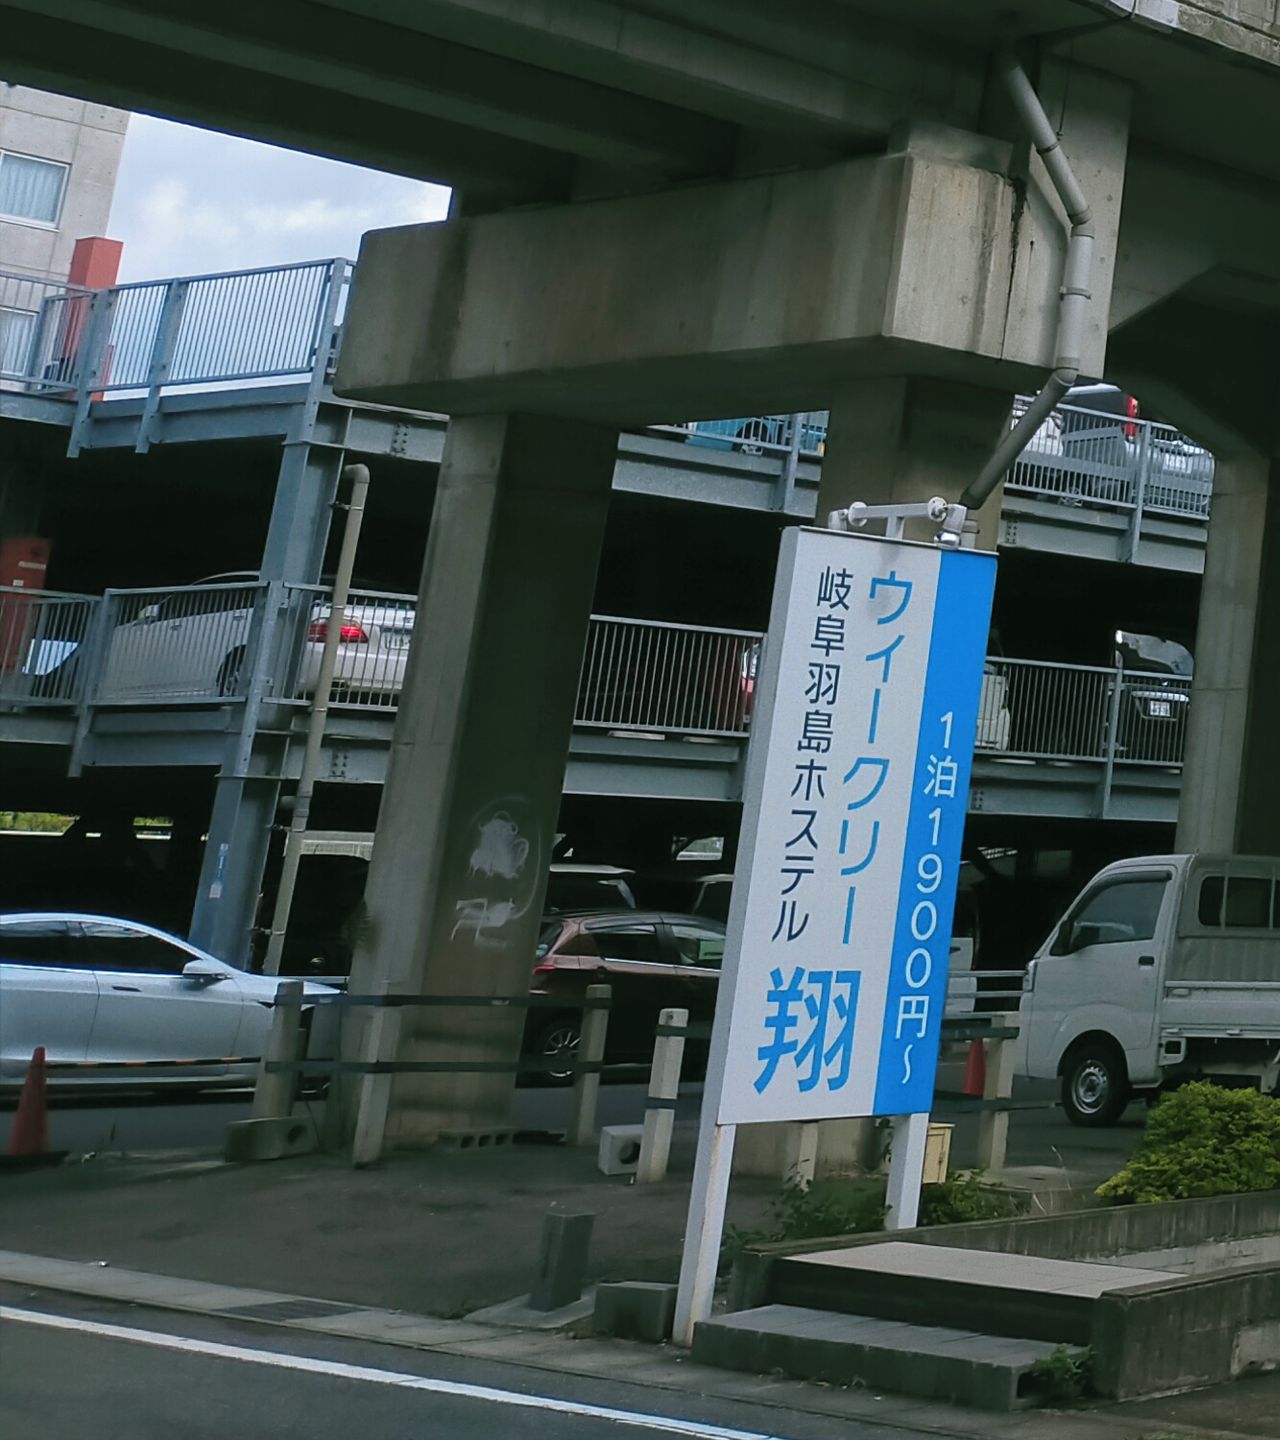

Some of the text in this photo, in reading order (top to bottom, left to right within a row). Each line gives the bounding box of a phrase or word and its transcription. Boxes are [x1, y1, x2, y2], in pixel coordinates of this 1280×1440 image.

[771, 565, 854, 943] 岐阜羽島ホステル
